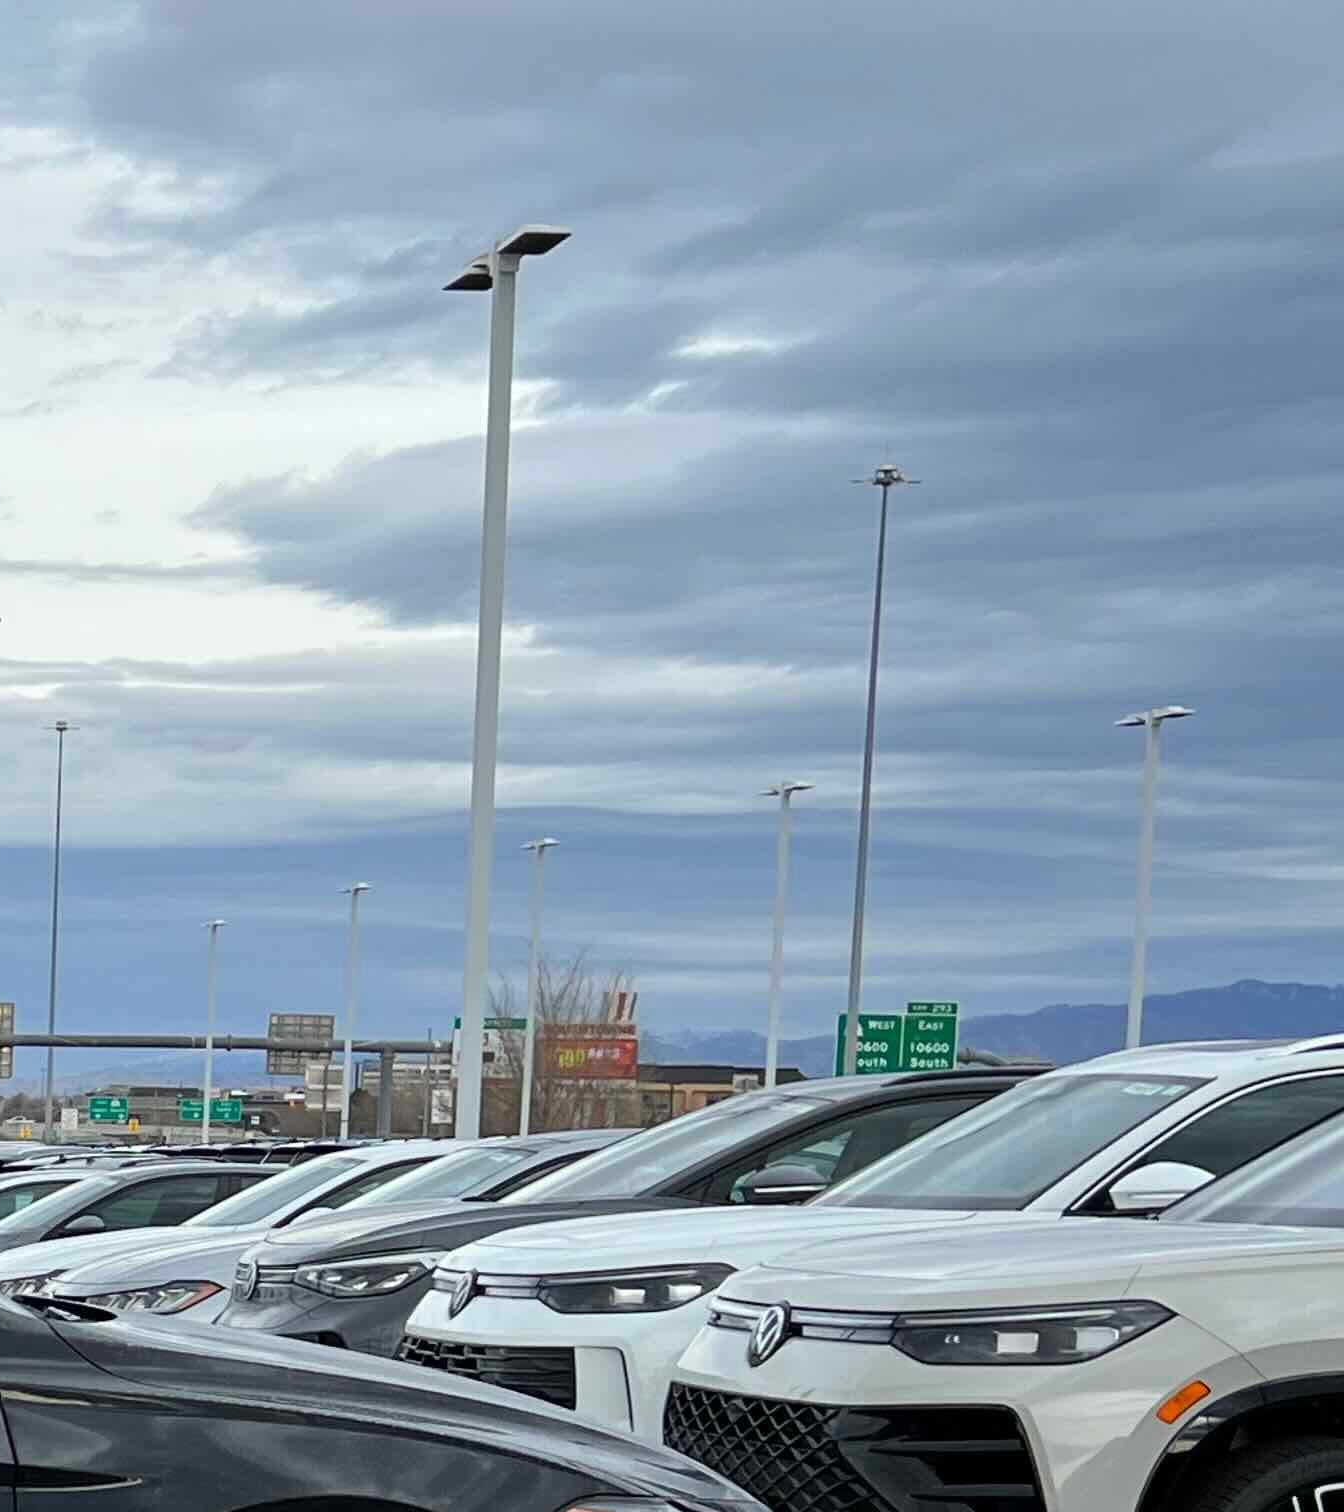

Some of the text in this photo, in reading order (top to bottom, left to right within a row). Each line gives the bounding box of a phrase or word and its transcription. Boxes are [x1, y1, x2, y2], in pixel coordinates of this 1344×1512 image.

[868, 1020, 895, 1031] WEST
[918, 1020, 944, 1031] EAST
[856, 1041, 889, 1053] 0600
[910, 1042, 950, 1054] 10600
[856, 1057, 888, 1068] outh
[909, 1057, 949, 1068] South
